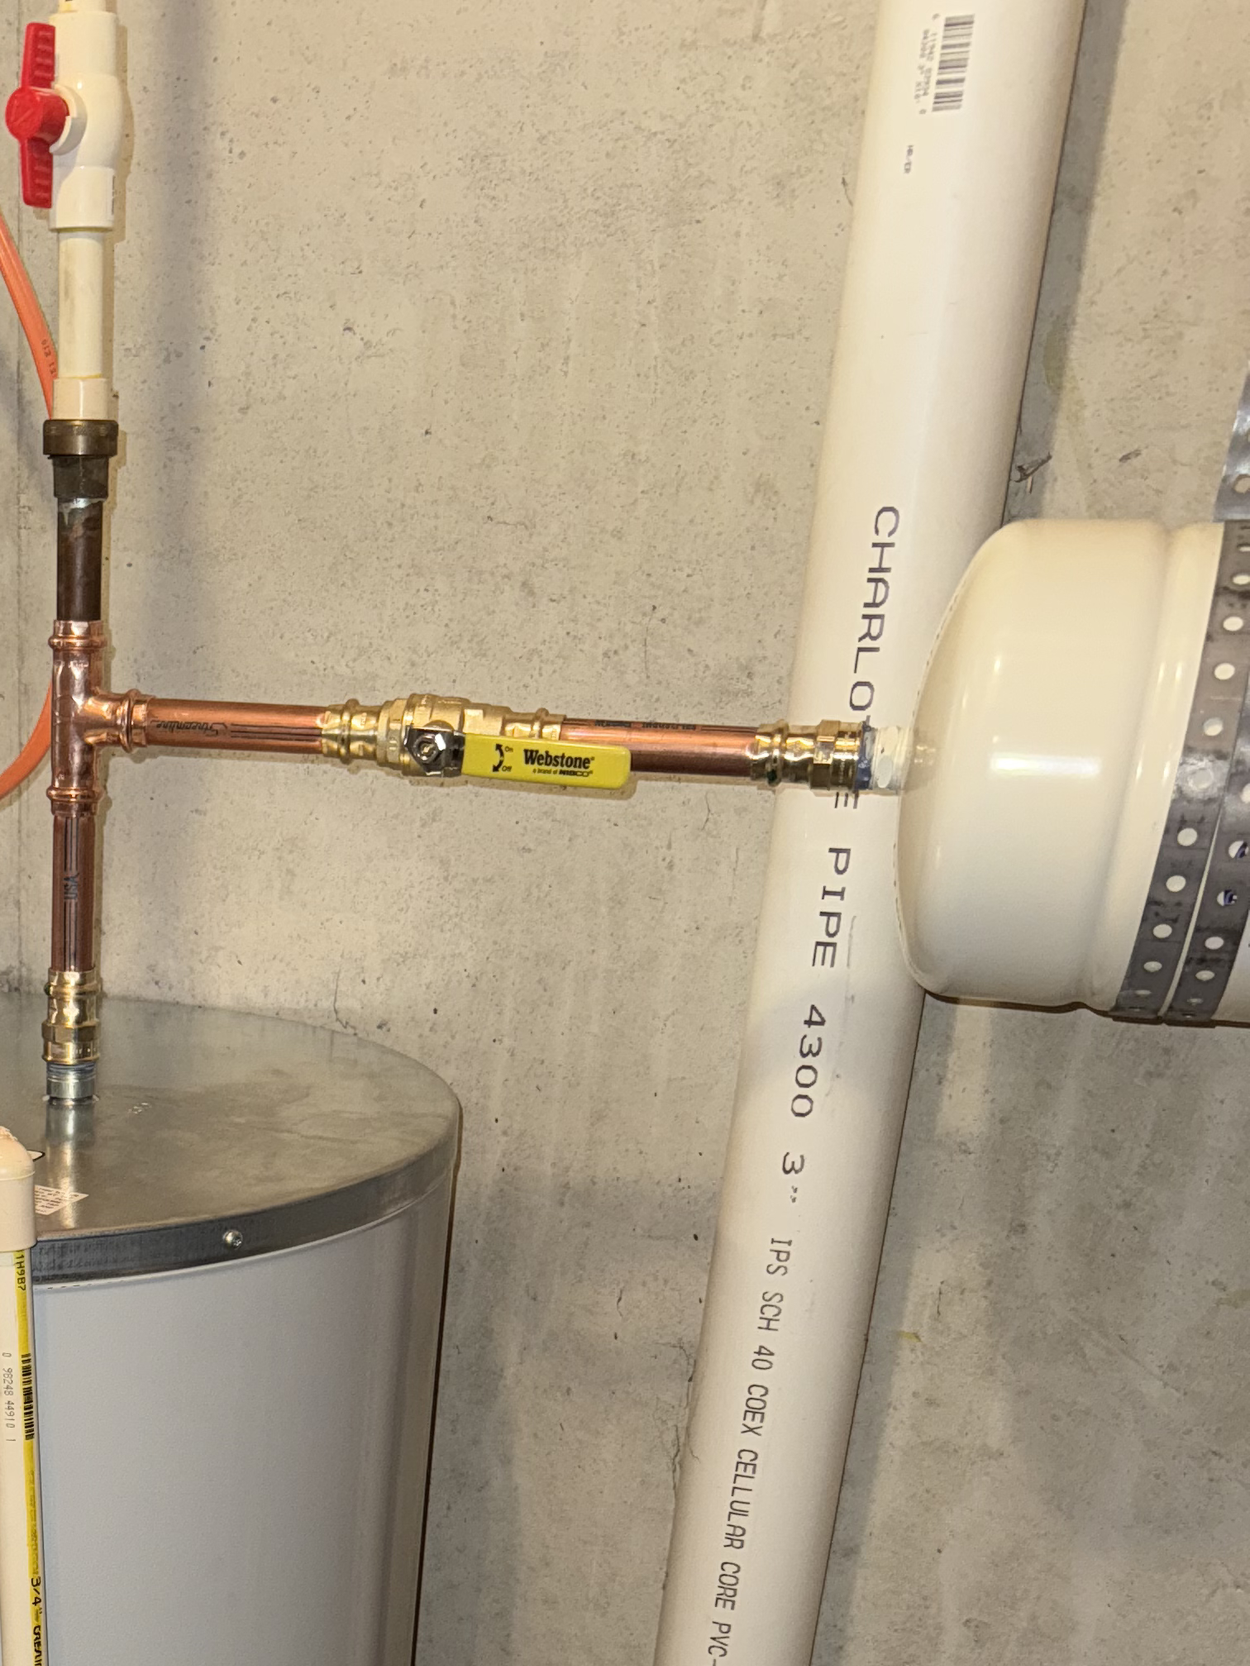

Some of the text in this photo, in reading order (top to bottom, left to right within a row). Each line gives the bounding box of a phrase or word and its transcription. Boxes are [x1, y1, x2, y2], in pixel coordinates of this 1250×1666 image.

[523, 749, 591, 770] Webstone
[812, 847, 851, 968] PIPE
[791, 1004, 826, 1118] 4300
[766, 1237, 792, 1276] IPS
[758, 1291, 784, 1331] SCH
[751, 1345, 775, 1371] 40
[740, 1383, 769, 1436] COEX
[723, 1449, 758, 1550] CELLULAR
[715, 1561, 741, 1610] CORE
